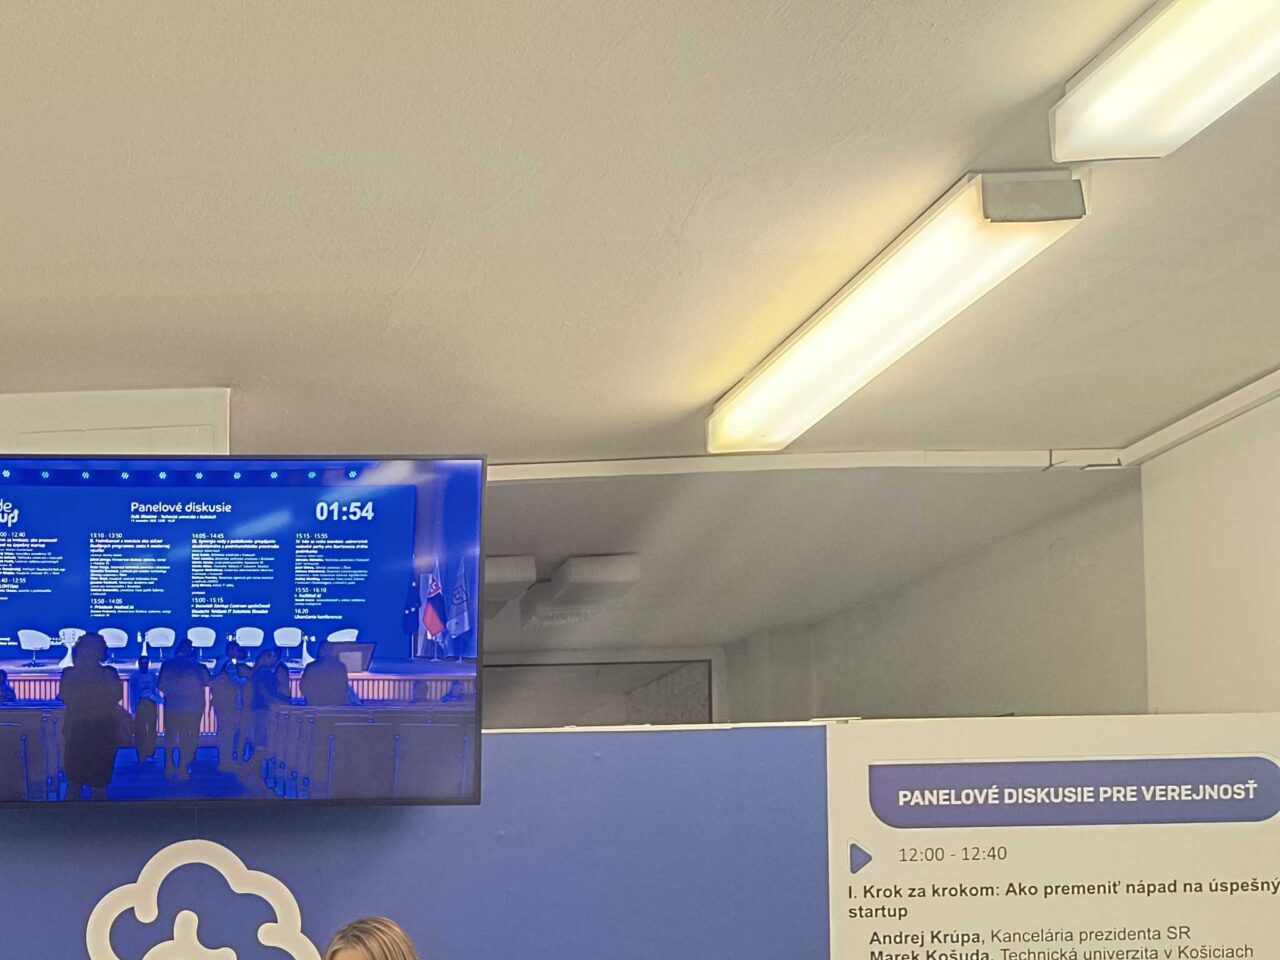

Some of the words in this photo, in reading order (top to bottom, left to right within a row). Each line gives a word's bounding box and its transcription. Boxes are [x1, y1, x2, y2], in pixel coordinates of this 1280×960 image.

[131, 501, 182, 512] Panelové
[185, 502, 232, 512] diskusie
[316, 501, 374, 520] 01:54
[899, 785, 1000, 806] PANELOVÉ
[1004, 786, 1095, 804] DISKUSIE
[1099, 786, 1138, 802] PRE
[1141, 780, 1258, 801] VEREJNOSŤ
[899, 847, 945, 862] 12:00
[961, 846, 1007, 861] 12:40
[863, 884, 903, 898] Krok
[908, 887, 926, 898] za
[932, 883, 999, 897] krokom:
[1005, 882, 1038, 896] Ako
[1044, 880, 1121, 899] premeniť
[1126, 879, 1177, 897] nápad
[1183, 882, 1203, 893] na
[1209, 877, 1280, 895] úspešný
[848, 905, 908, 920] startup
[869, 930, 924, 948] Andrej
[930, 930, 985, 947] Krúpa,
[991, 928, 1073, 943] Kancelária
[1079, 927, 1161, 944] prezidenta
[1167, 925, 1191, 940] SR
[1083, 946, 1158, 960] univerzita
[1178, 944, 1253, 959] Košiciach
